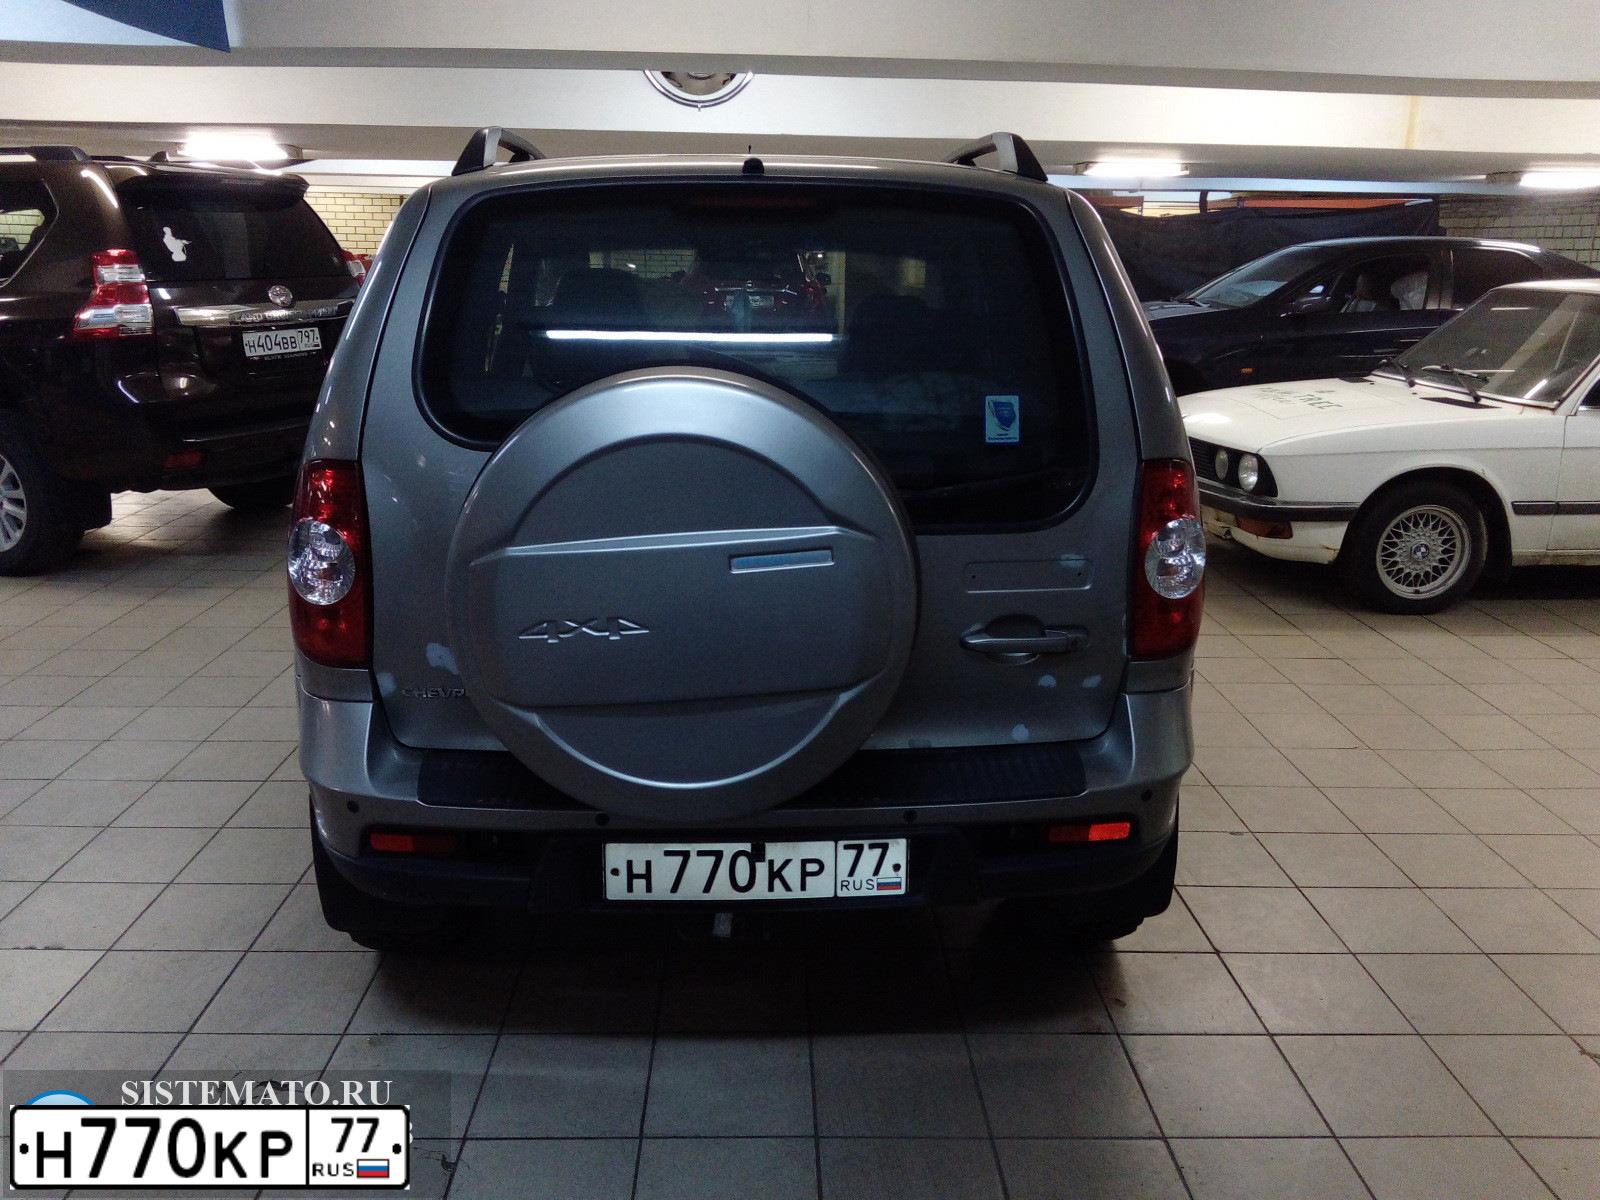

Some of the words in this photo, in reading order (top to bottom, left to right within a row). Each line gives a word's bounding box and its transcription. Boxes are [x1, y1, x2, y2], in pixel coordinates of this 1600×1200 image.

[298, 329, 315, 343] 797
[625, 848, 826, 894] Н770КР
[842, 842, 890, 878] 77
[840, 878, 875, 892] RUS
